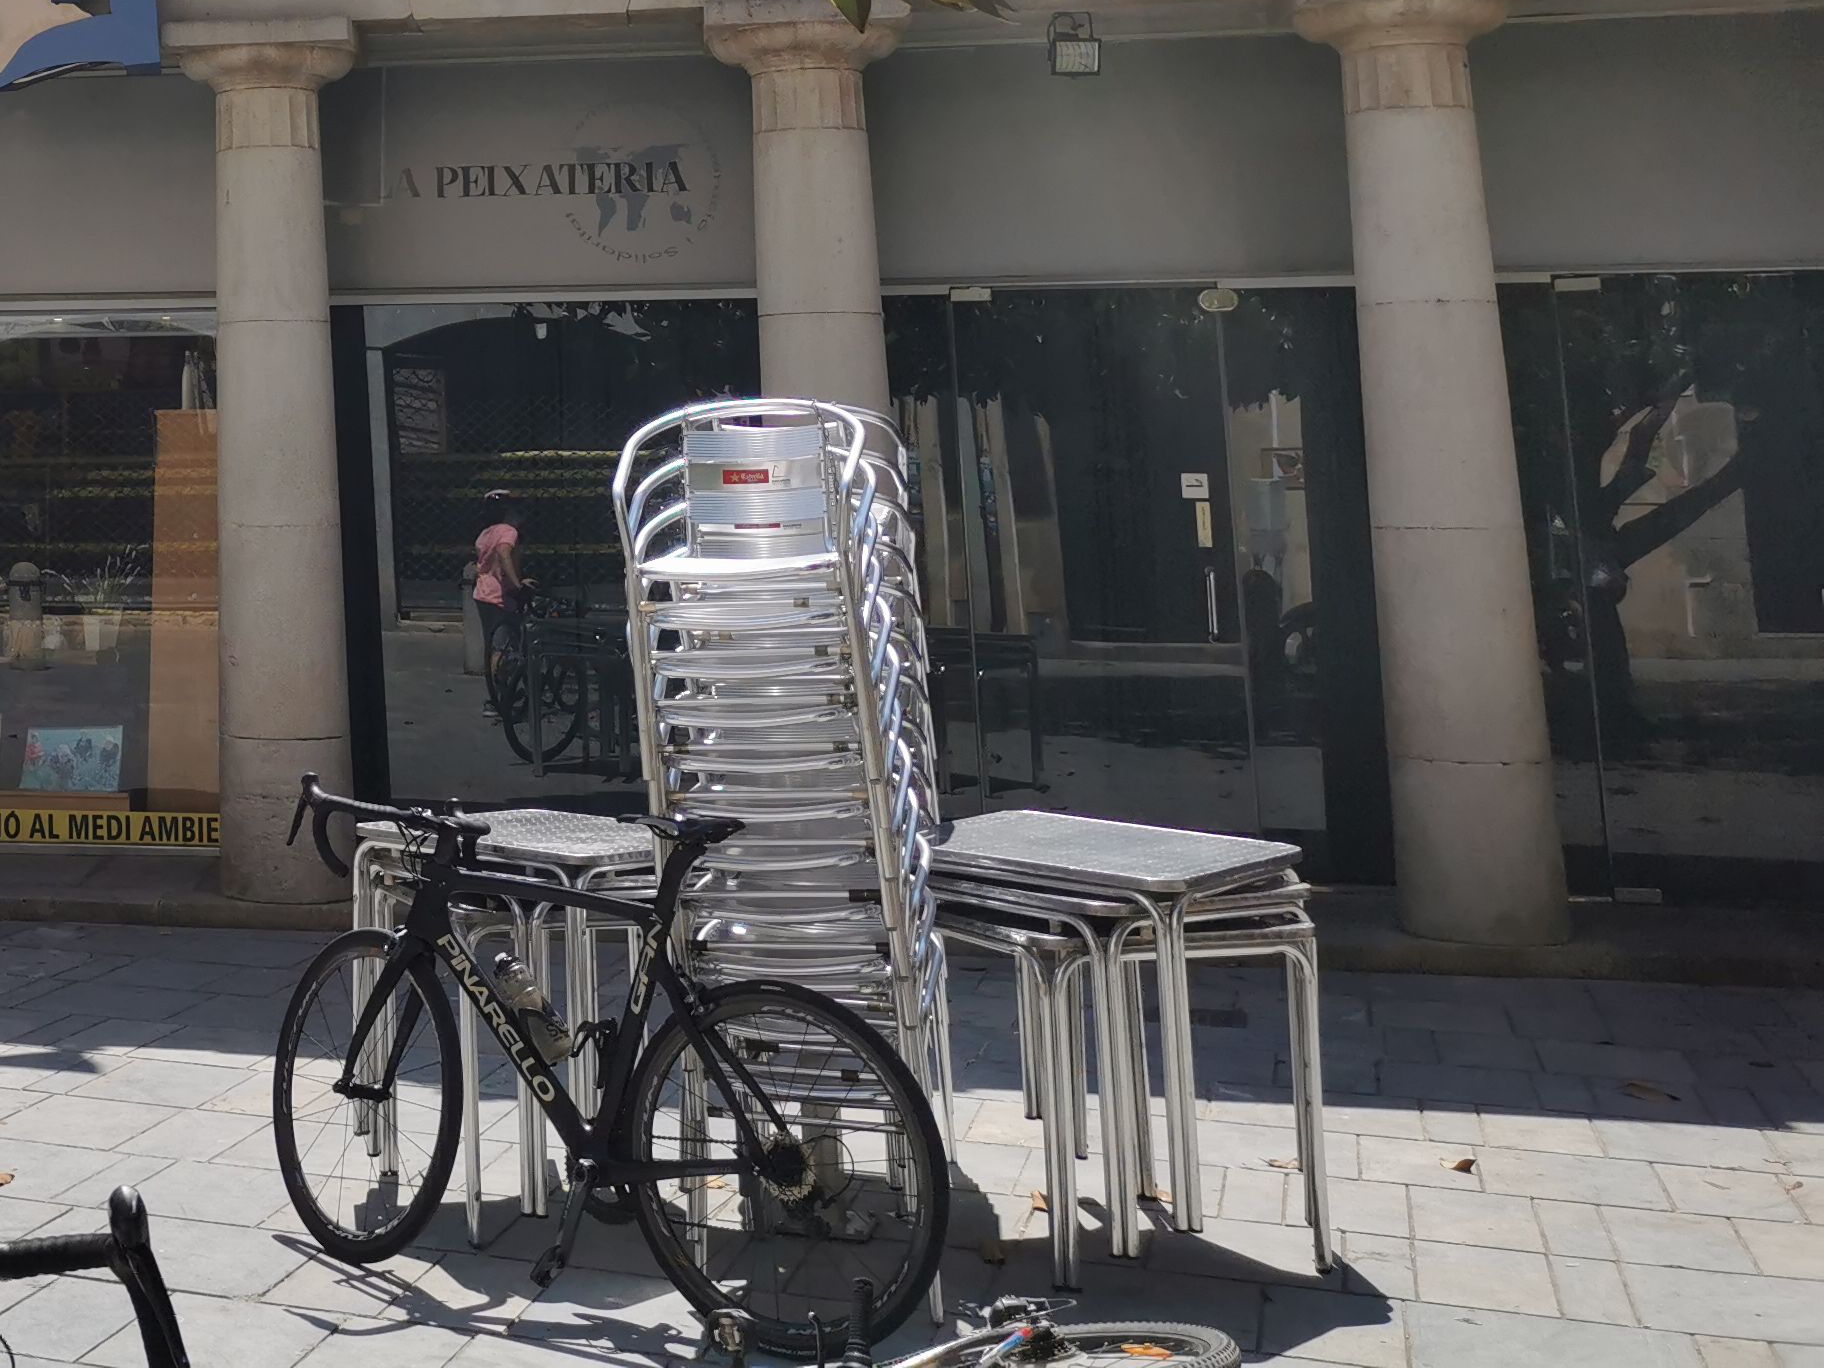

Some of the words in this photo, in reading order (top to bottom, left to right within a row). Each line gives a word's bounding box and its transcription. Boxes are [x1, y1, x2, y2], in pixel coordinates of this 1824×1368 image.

[380, 167, 422, 199] A
[435, 160, 690, 199] PEIXATERIA
[29, 813, 60, 840] AL
[68, 814, 130, 841] MEDI
[436, 933, 556, 1102] PINARELLO
